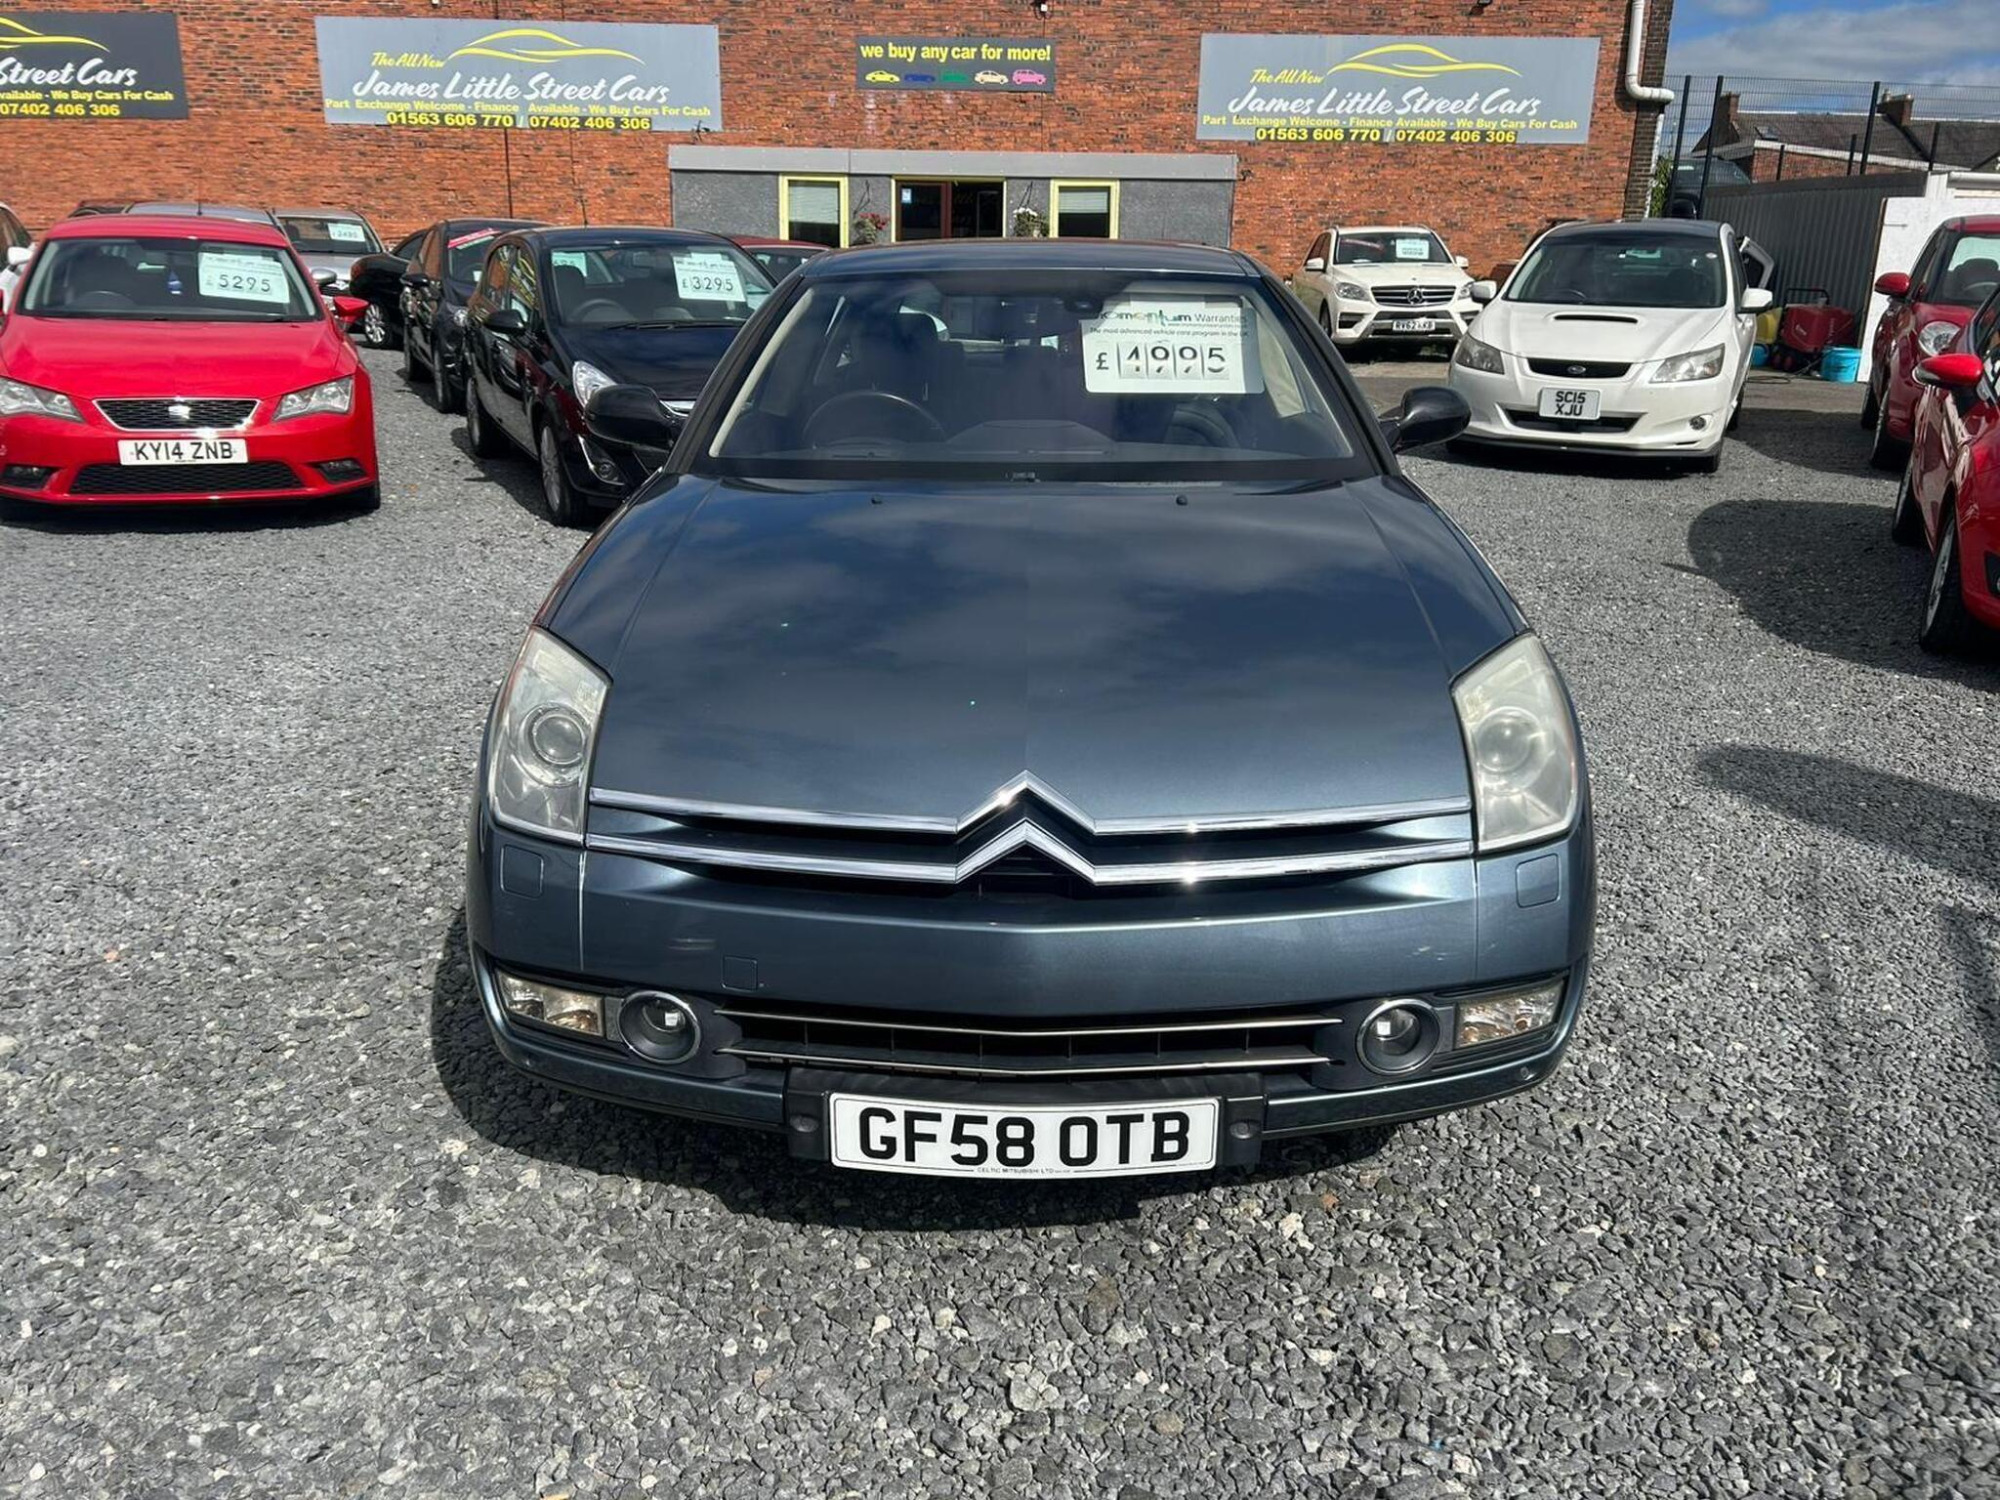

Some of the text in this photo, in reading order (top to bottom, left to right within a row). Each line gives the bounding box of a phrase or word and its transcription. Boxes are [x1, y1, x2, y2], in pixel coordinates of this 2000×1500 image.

[371, 52, 445, 68] The All New
[860, 42, 1051, 63] we buy any car for more!
[0, 57, 138, 86] Street Cars
[1250, 69, 1325, 84] The All New
[352, 69, 670, 103] James Little Street Cars
[0, 90, 42, 100] vailable
[51, 90, 69, 100] We
[71, 90, 93, 102] Buy
[94, 91, 122, 100] Cars
[124, 91, 142, 100] For
[144, 91, 174, 101] Cash
[1228, 85, 1541, 116] James Little Street Cars
[0, 103, 120, 116] 07402 406 306
[325, 98, 350, 108] Part
[356, 99, 411, 111] Exchange
[413, 100, 465, 111] Welcome
[474, 102, 519, 112] Finance
[528, 103, 579, 113] Available
[588, 105, 606, 114] We
[609, 105, 630, 117] Buy
[634, 105, 659, 115] Cars
[662, 106, 680, 115] For
[682, 106, 710, 116] Cash
[387, 112, 440, 125] 01563
[444, 113, 476, 126] 606
[481, 114, 513, 127] 770
[529, 116, 580, 128] 07402
[585, 117, 615, 128] 406
[620, 117, 650, 129] 306
[1203, 115, 1226, 125] Part
[1233, 116, 1286, 127] Exchange
[1290, 116, 1340, 127] Welcome
[1350, 117, 1393, 127] Finance
[1396, 118, 1447, 128] Available
[1456, 118, 1473, 128] We
[1477, 119, 1497, 130] Buy
[1500, 119, 1525, 129] Cars
[1529, 119, 1547, 129] For
[1550, 120, 1577, 129] Cash
[1256, 128, 1308, 140] 01563
[1312, 128, 1344, 141] 606
[1349, 129, 1380, 141] 770
[1396, 130, 1445, 142] 07402
[1451, 131, 1480, 142] 406
[1486, 131, 1516, 142] 306
[219, 274, 271, 292] 5295
[692, 276, 734, 291] 3295
[1096, 352, 1109, 370] £
[1555, 391, 1586, 404] SC15
[1555, 404, 1583, 416] XJU
[134, 441, 233, 460] KY14 ZNB
[858, 1107, 1190, 1167] GF58 OTB
